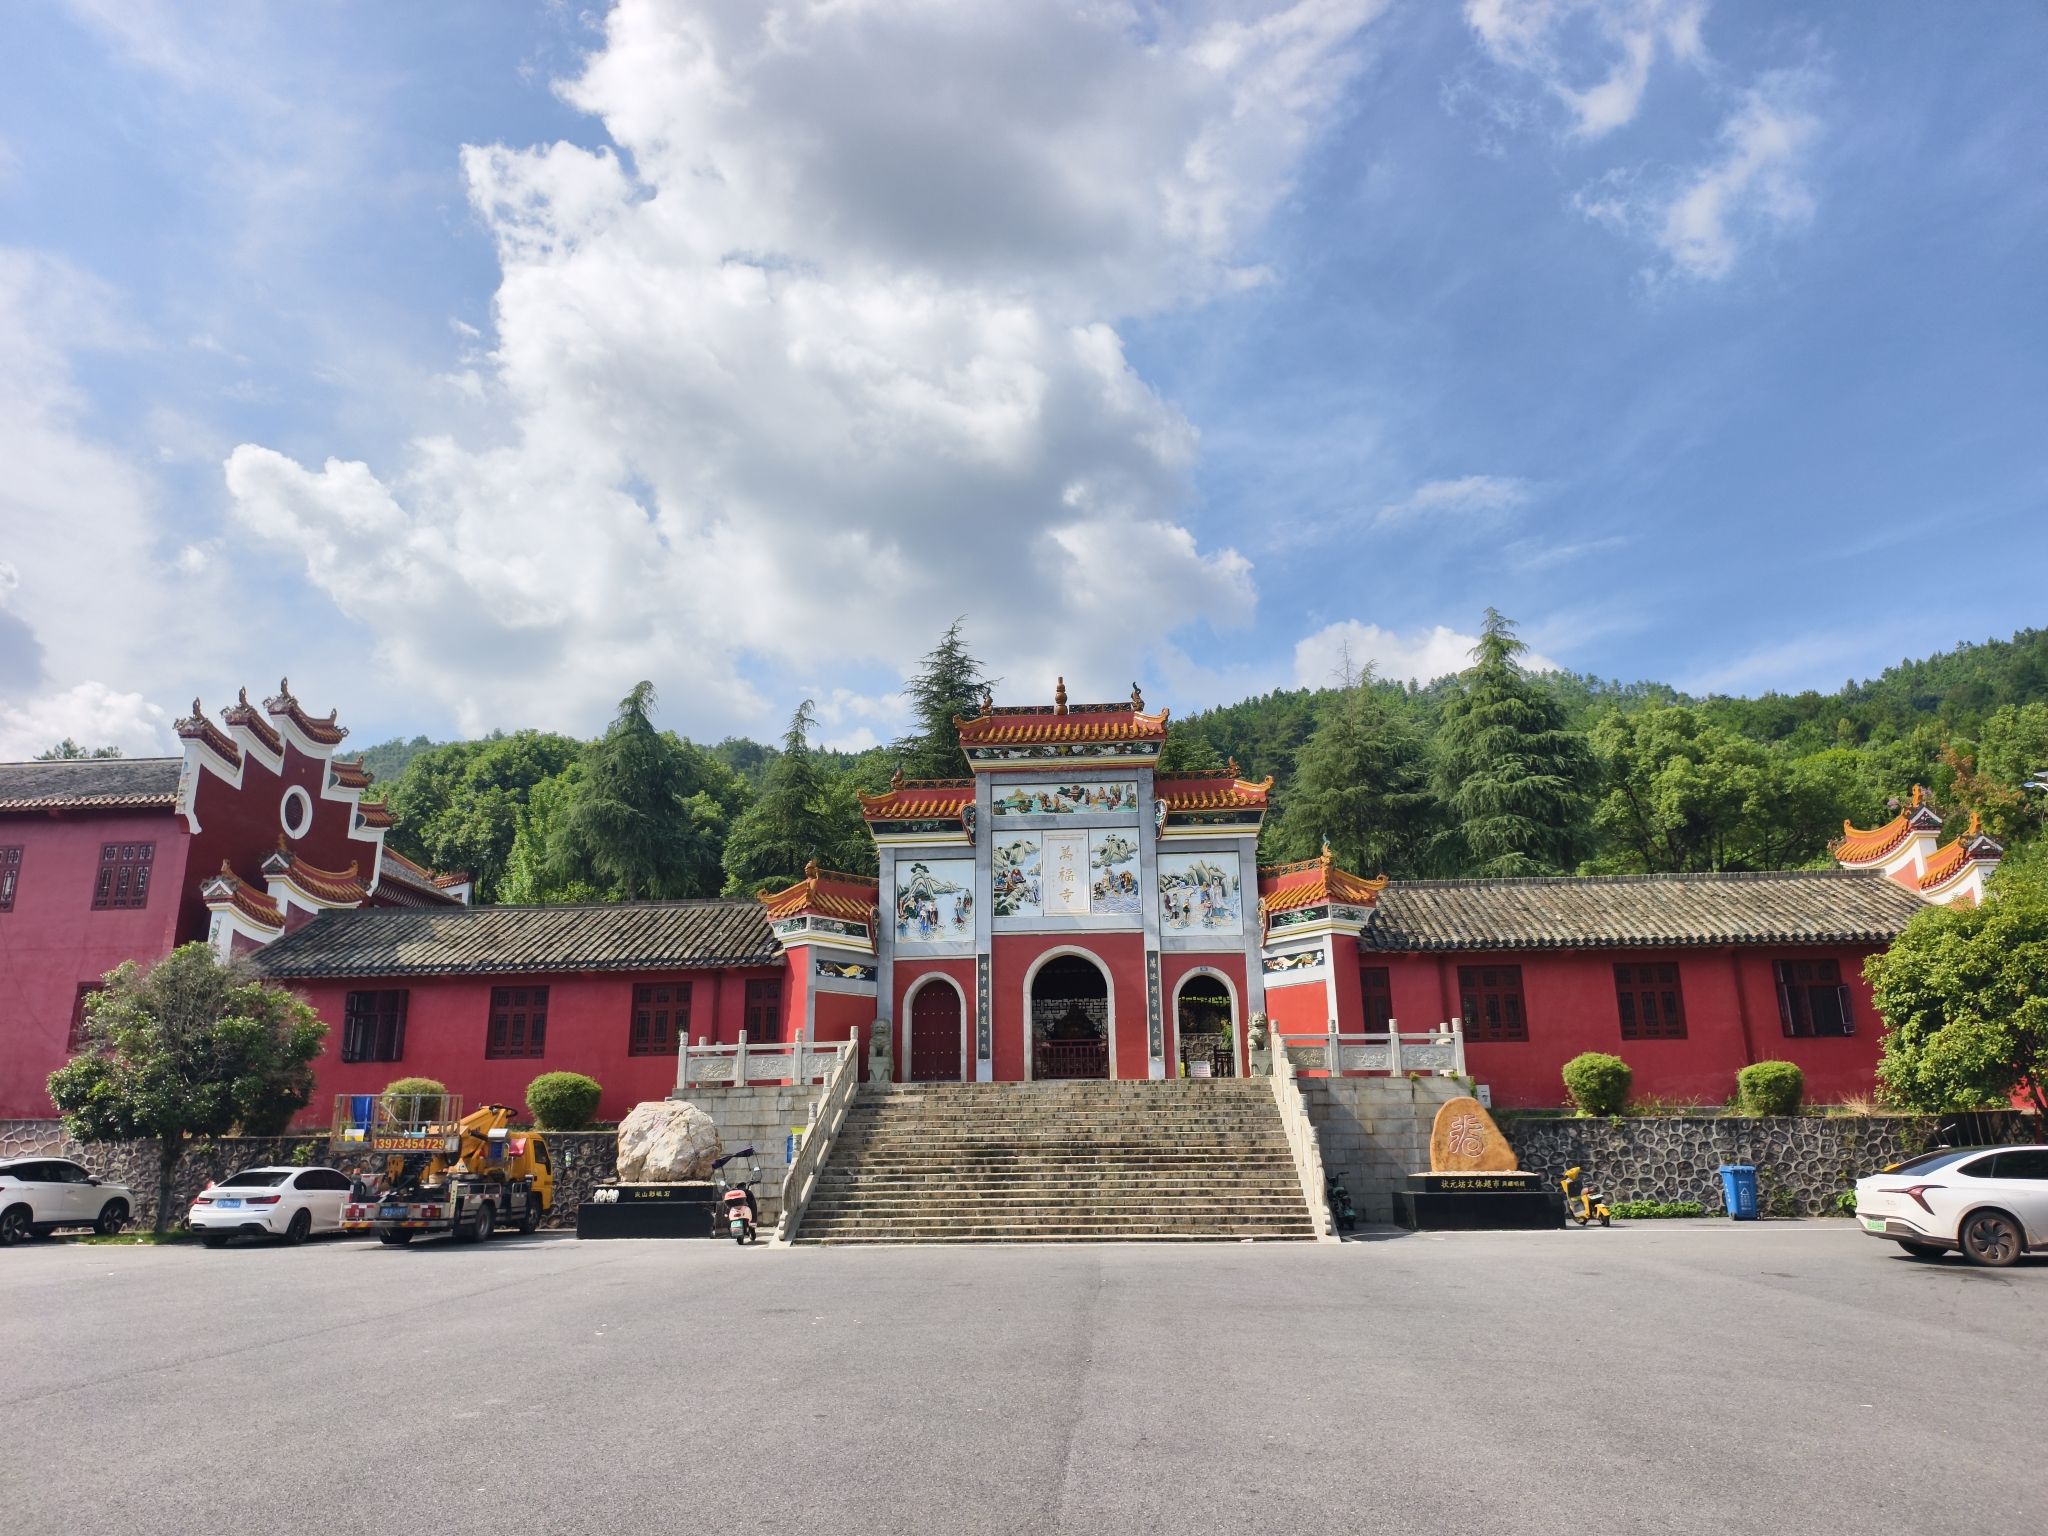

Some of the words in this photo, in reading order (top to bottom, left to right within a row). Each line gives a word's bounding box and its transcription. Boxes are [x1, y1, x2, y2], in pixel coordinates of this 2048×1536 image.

[1059, 845, 1075, 903] 萬福寺
[373, 1138, 445, 1149] 13973454729
